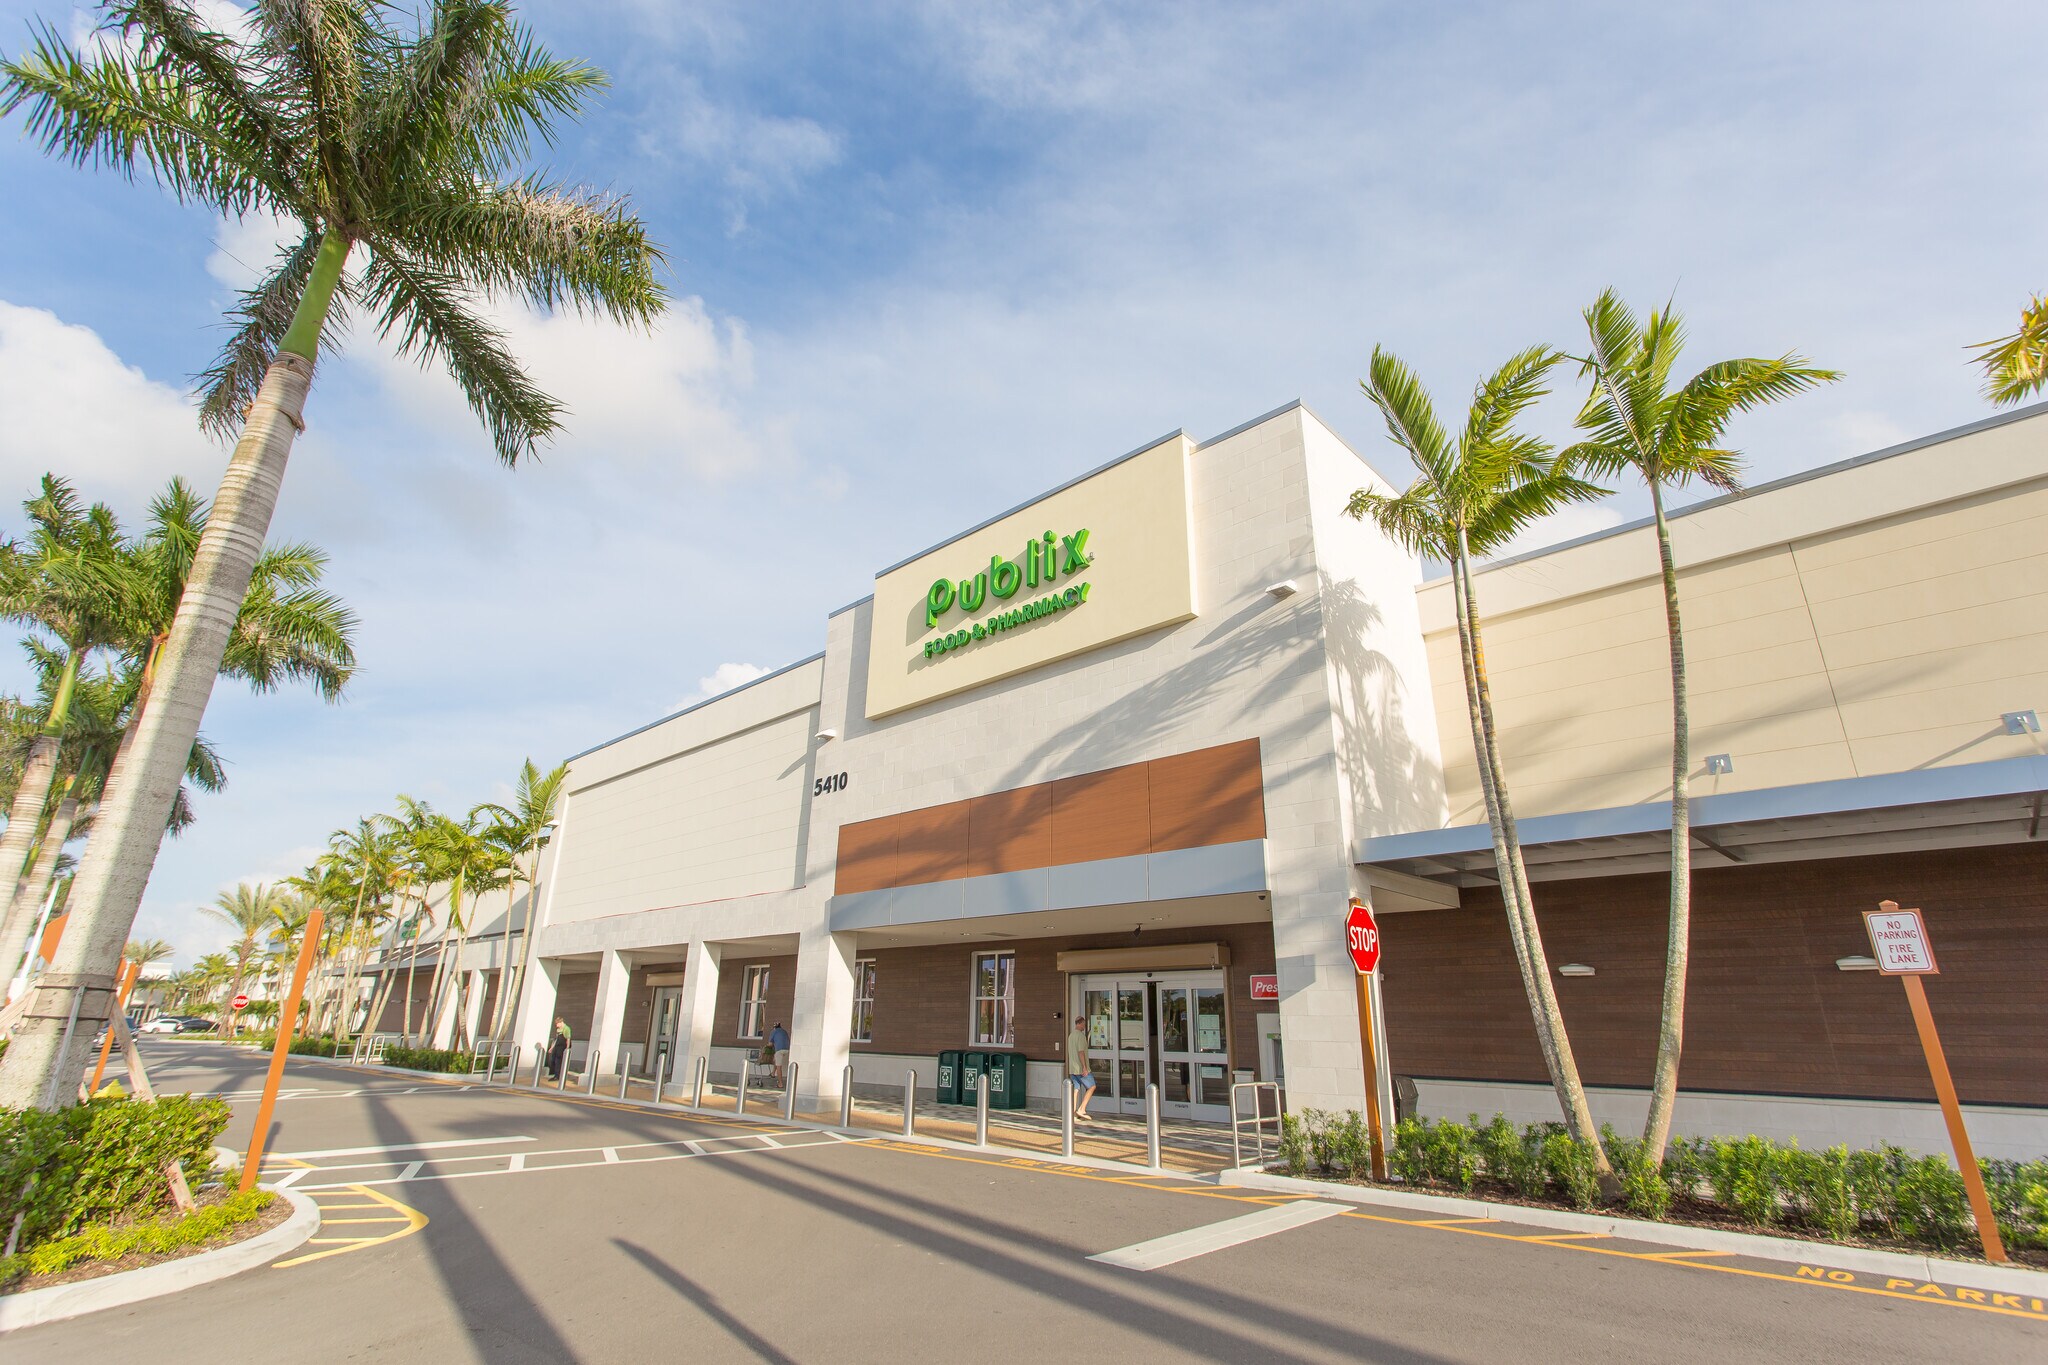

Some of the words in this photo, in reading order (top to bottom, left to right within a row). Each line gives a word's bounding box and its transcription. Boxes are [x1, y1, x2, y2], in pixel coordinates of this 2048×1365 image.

[926, 528, 1091, 629] Publix
[923, 629, 971, 659] FOOD
[971, 623, 987, 641] &
[987, 581, 1091, 636] PHARMACY
[814, 771, 848, 797] 5410
[1876, 929, 1918, 940] PARKING
[1886, 920, 1901, 930] NO
[1349, 925, 1377, 953] STOP
[1888, 943, 1914, 954] FIRE
[1889, 953, 1920, 964] LANE
[1796, 1265, 1856, 1283] NO
[1885, 1278, 2044, 1312] PARKI
